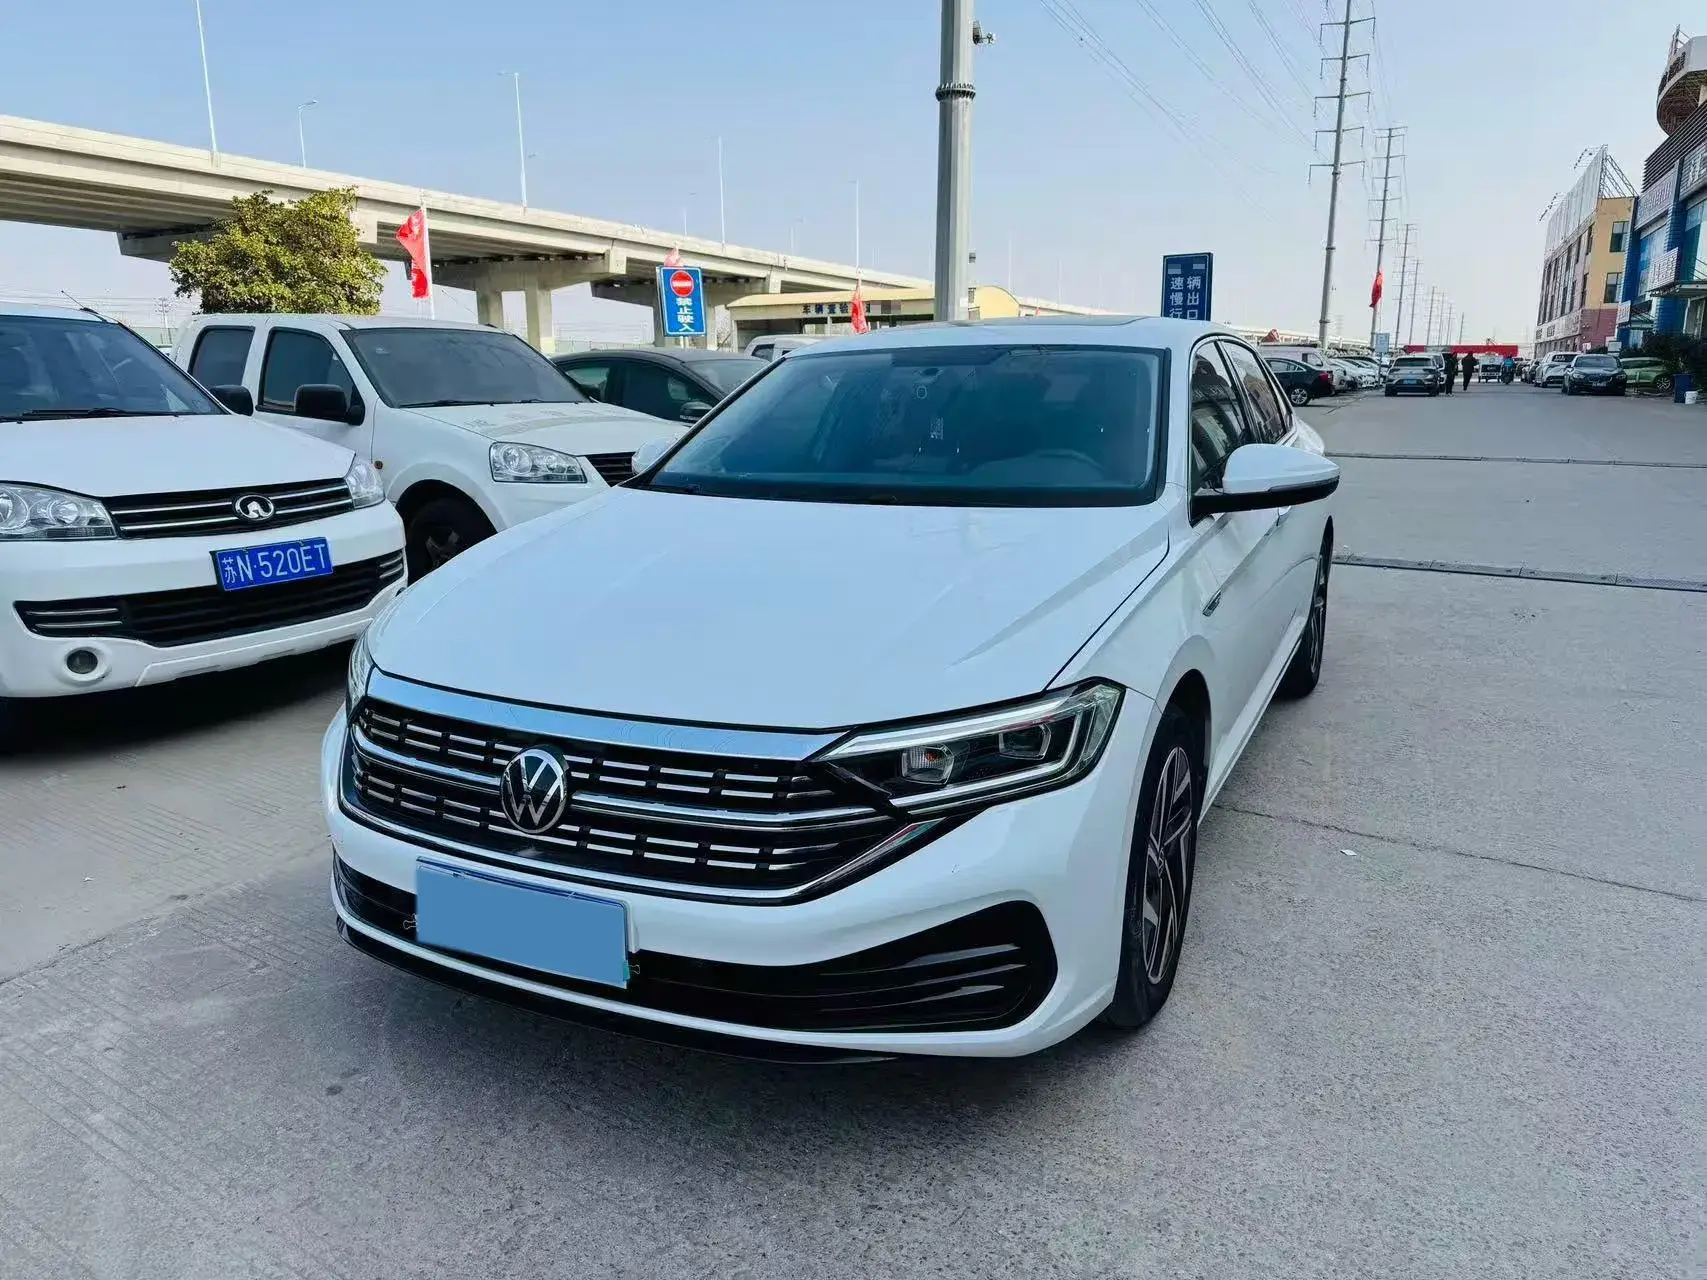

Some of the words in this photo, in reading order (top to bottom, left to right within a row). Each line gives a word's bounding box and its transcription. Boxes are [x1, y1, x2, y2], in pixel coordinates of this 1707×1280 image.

[675, 297, 695, 331] 禁止驶入
[1168, 264, 1184, 319] 速慢行
[1186, 264, 1203, 319] 辆出口
